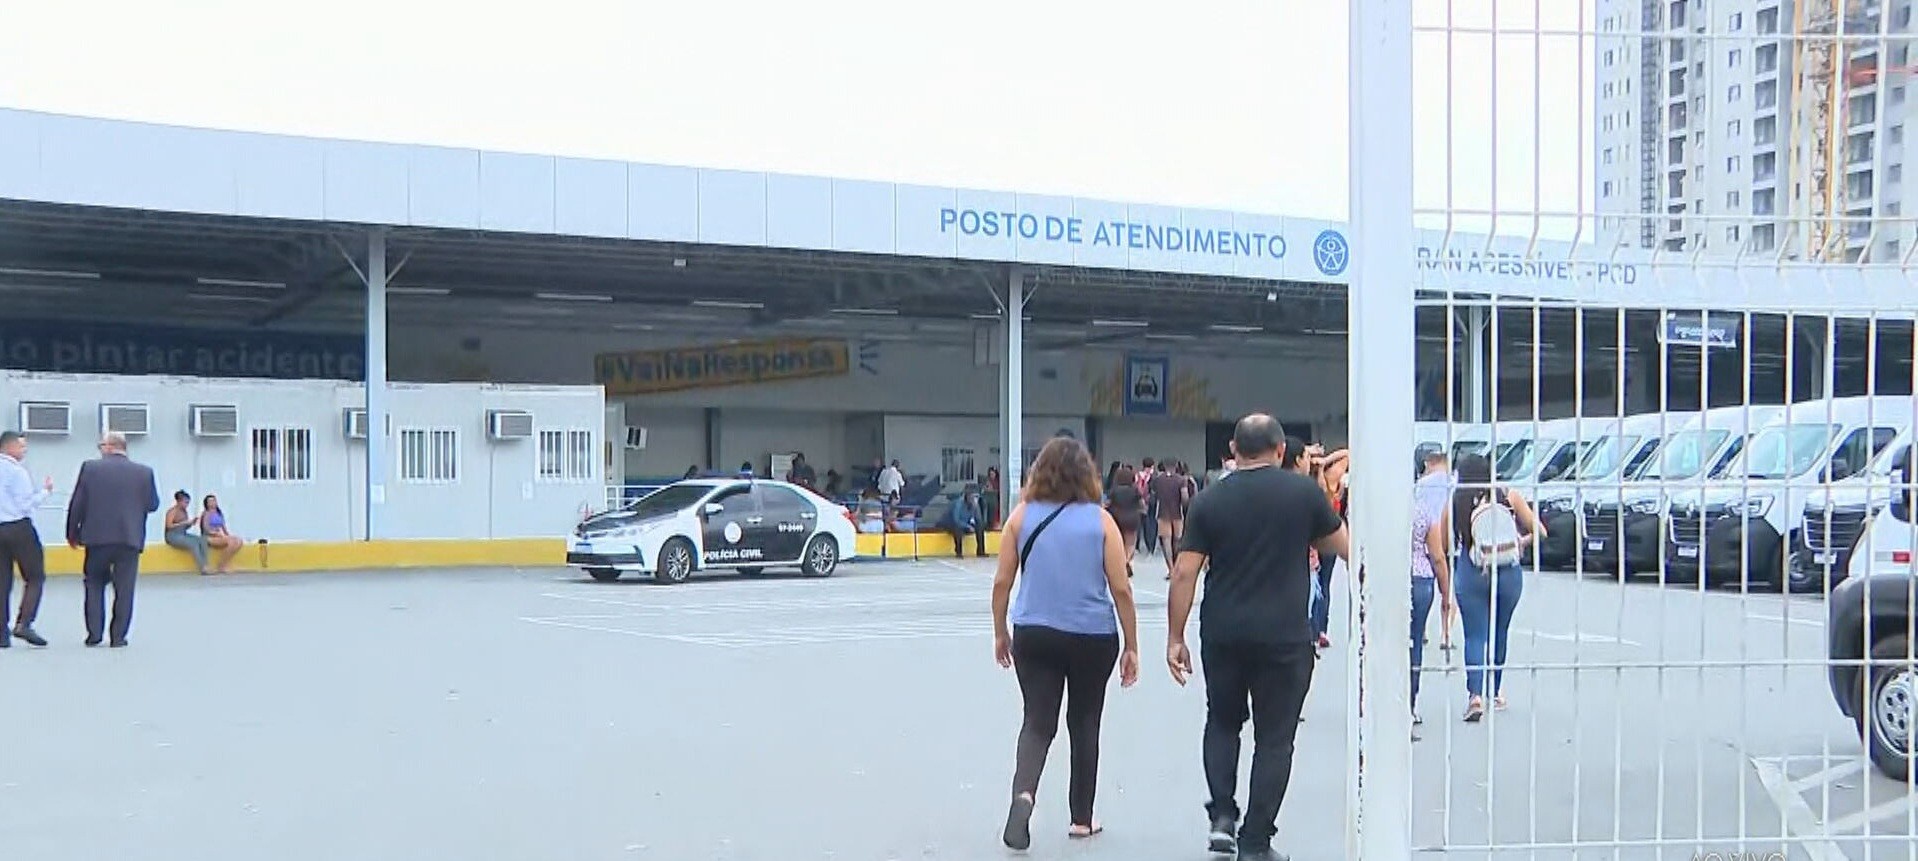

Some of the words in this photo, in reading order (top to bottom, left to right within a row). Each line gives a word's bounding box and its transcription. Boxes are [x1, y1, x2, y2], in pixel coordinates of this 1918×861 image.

[940, 208, 1039, 239] POSTO
[1045, 216, 1083, 243] DE
[1093, 221, 1287, 259] ATENDIMENTO
[740, 548, 763, 559] CIVIL
